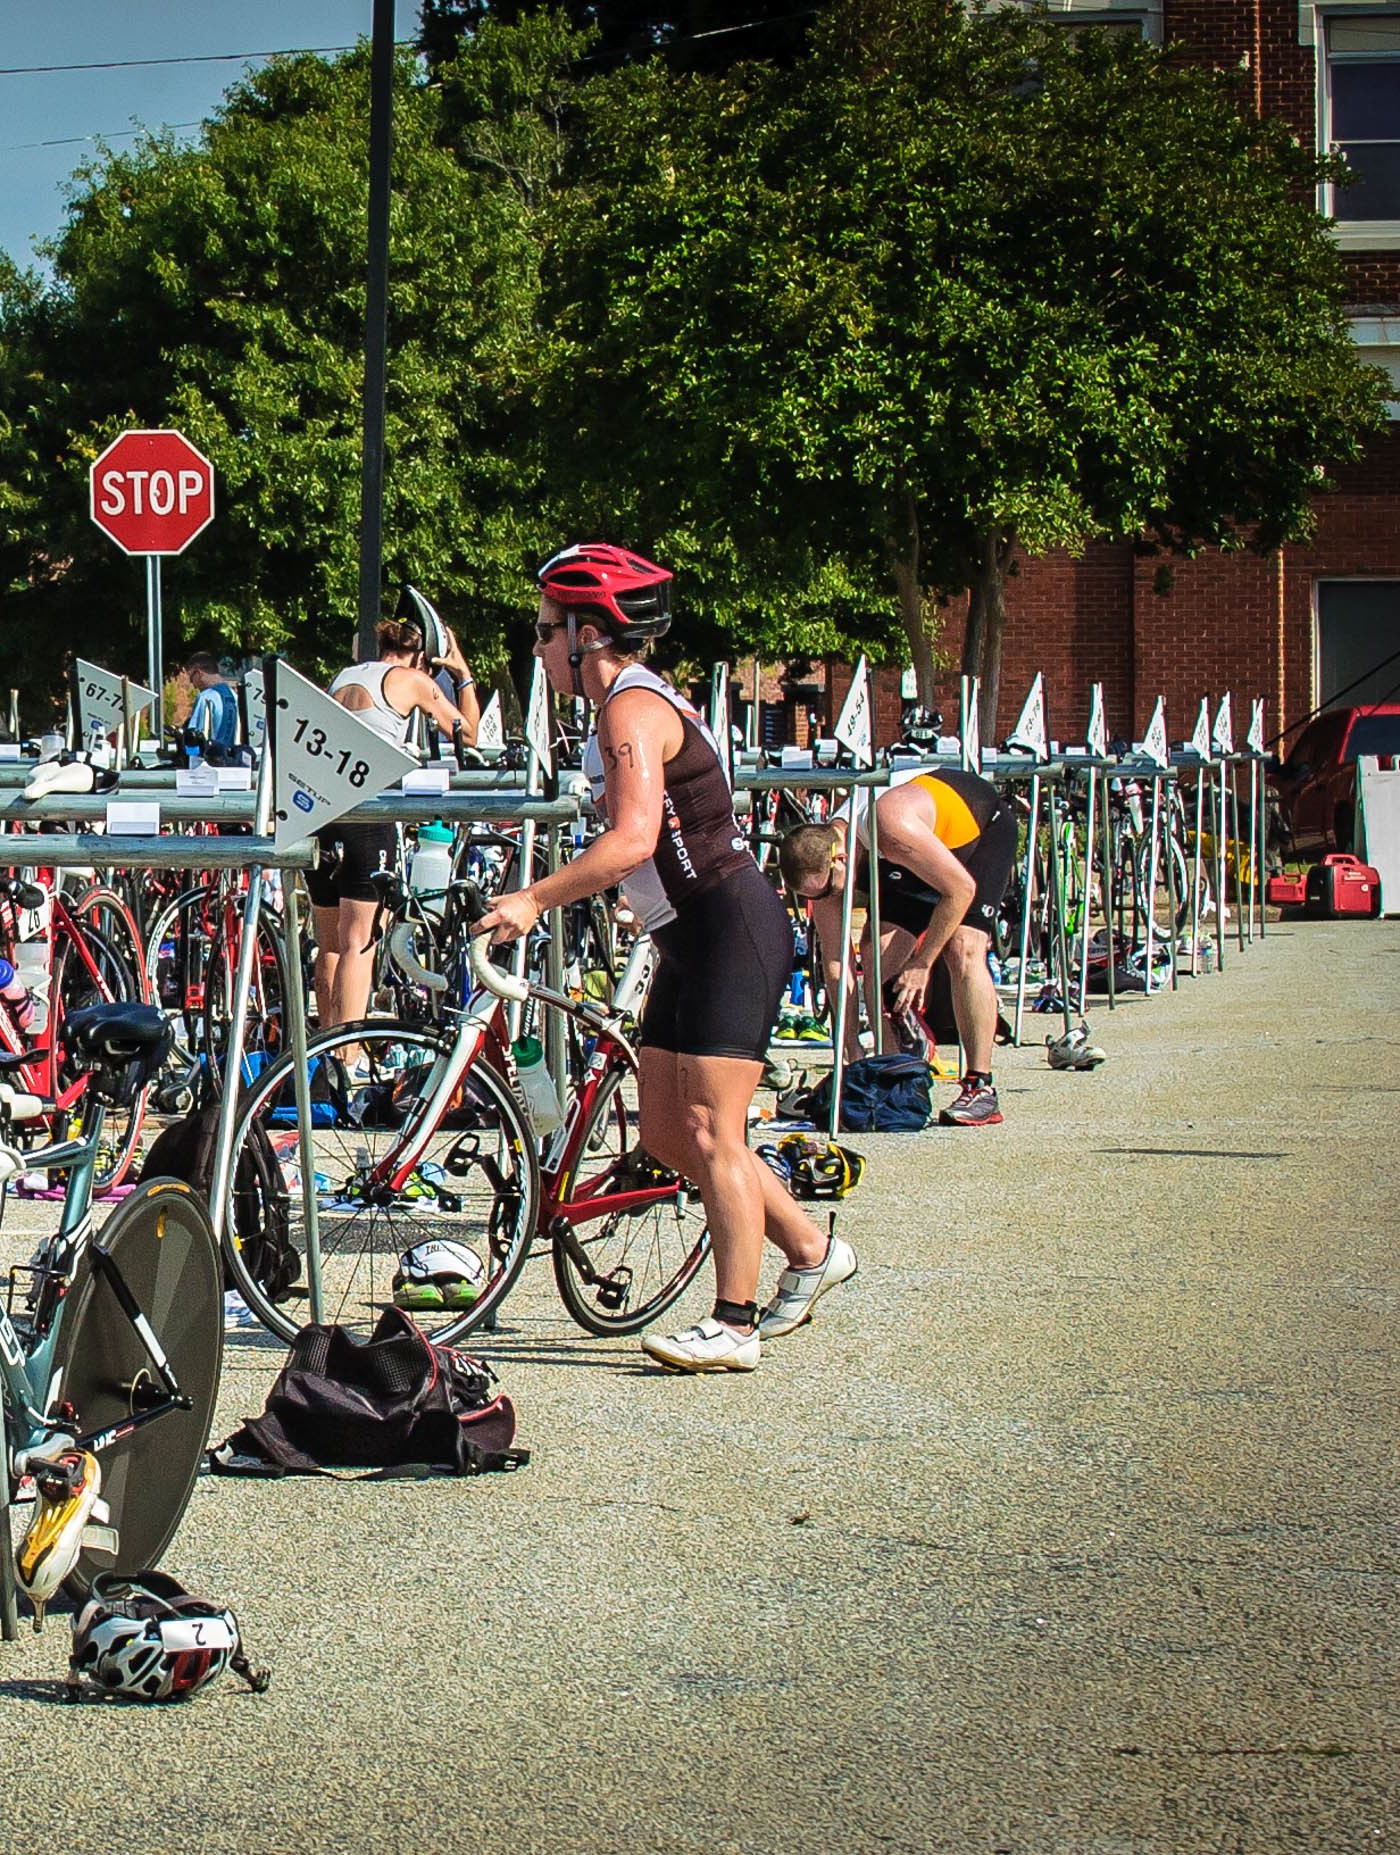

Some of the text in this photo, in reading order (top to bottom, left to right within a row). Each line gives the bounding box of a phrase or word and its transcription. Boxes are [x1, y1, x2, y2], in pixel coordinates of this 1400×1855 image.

[101, 469, 204, 515] STOP
[293, 718, 370, 788] 13-18
[671, 829, 698, 879] SPORT
[192, 1622, 207, 1646] 2
